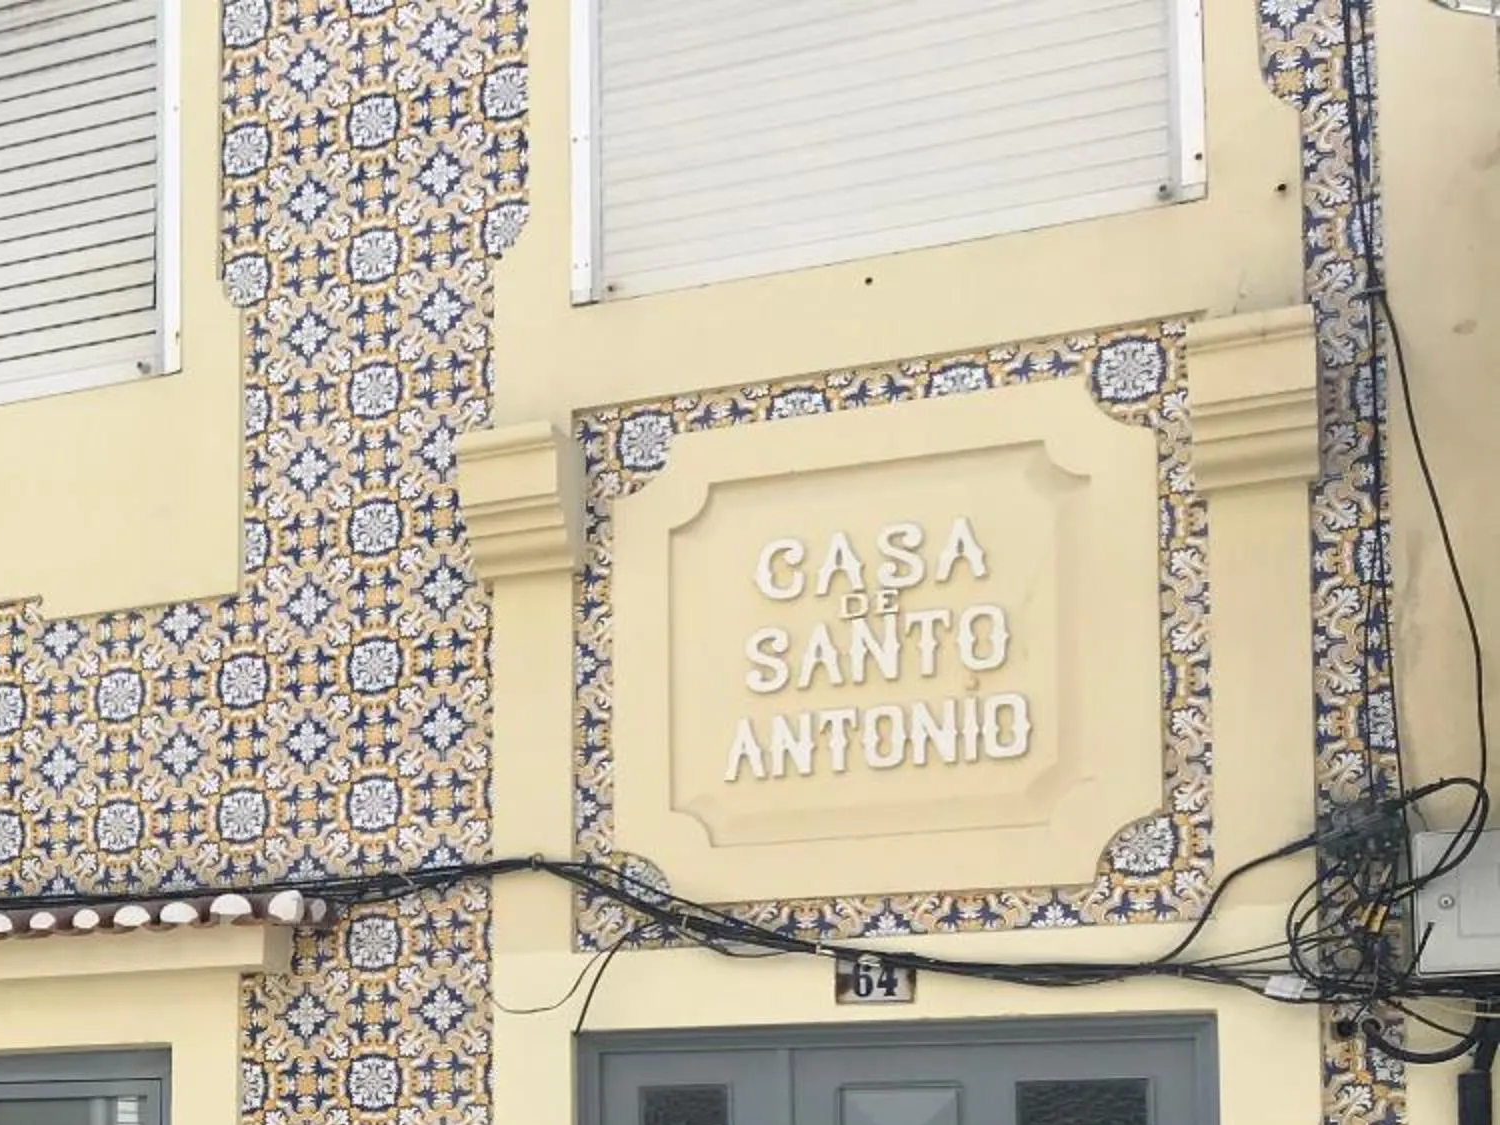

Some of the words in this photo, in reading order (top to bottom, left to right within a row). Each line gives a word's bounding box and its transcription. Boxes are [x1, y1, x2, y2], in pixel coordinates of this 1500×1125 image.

[755, 516, 988, 601] CASA
[838, 588, 900, 620] DE
[744, 604, 1011, 693] SANTO
[724, 692, 1032, 782] ANTONIO
[853, 961, 899, 997] 64
